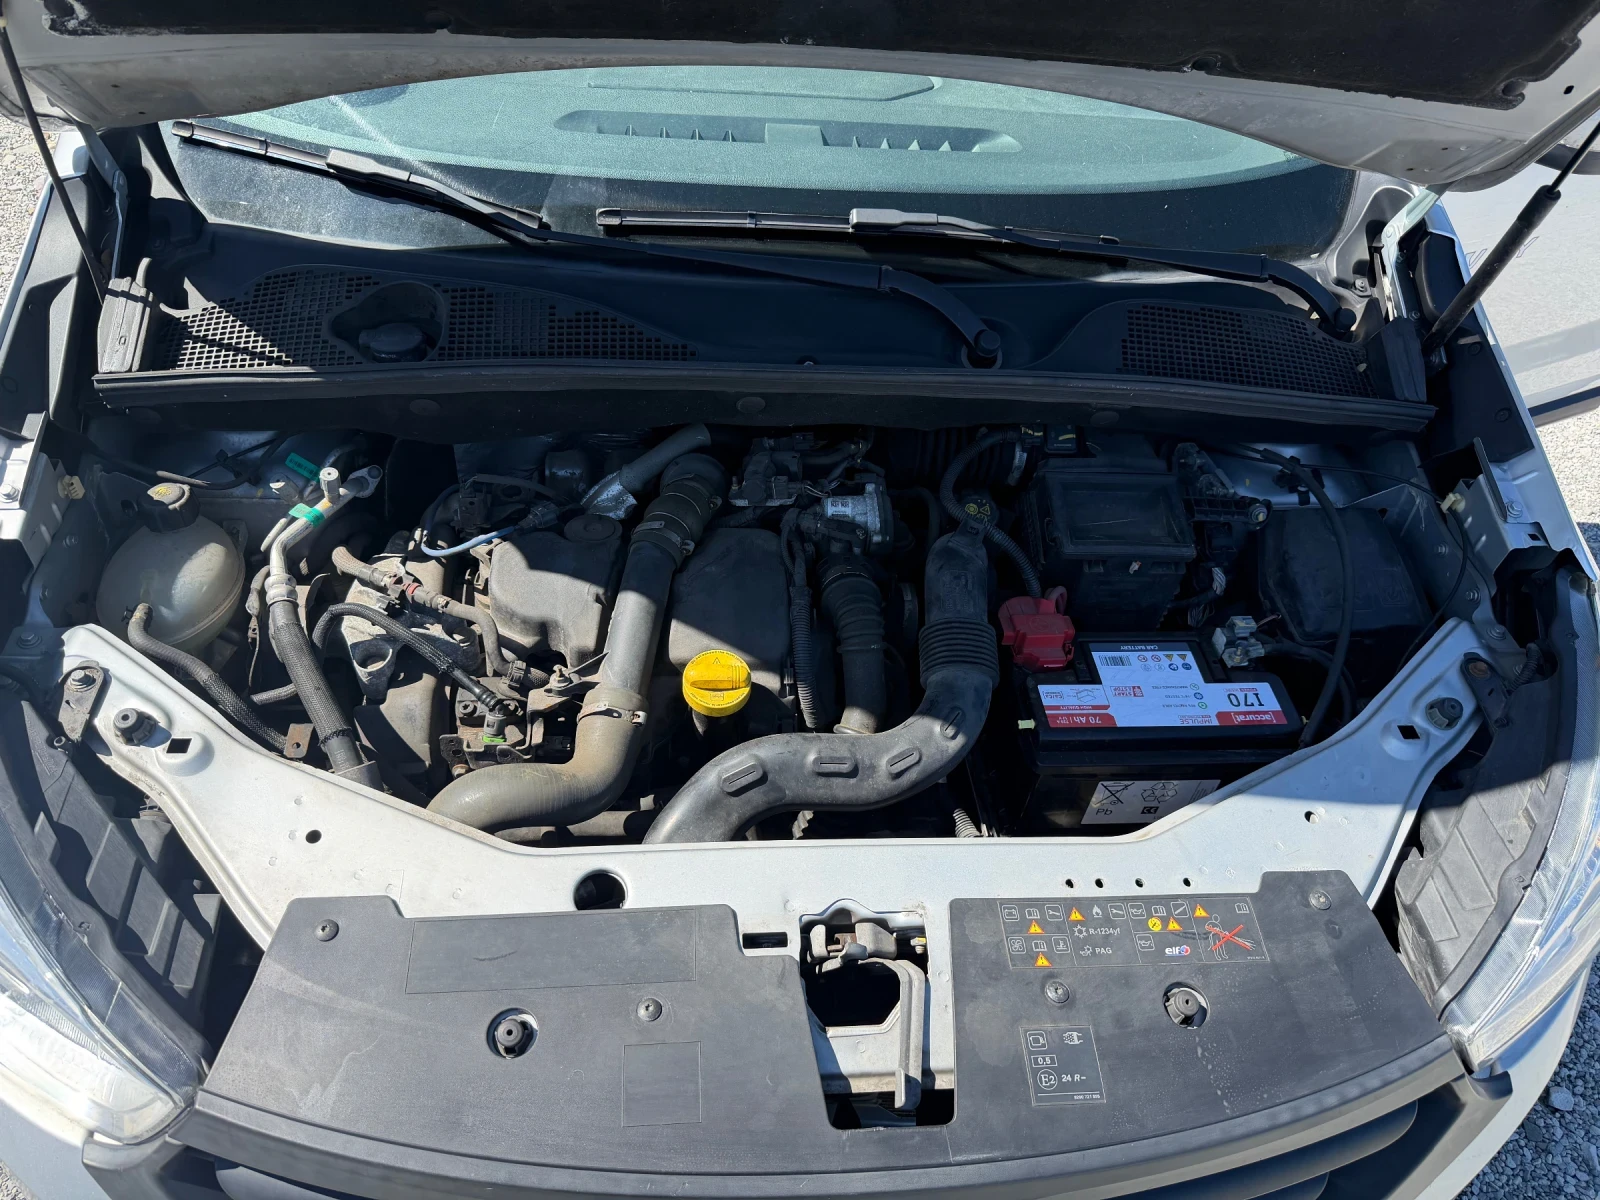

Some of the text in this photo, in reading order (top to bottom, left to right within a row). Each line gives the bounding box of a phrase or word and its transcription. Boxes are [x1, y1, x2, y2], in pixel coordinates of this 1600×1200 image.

[1089, 716, 1102, 724] 70
[1095, 808, 1113, 816] Pb
[1089, 928, 1120, 936] R-1234yf
[1164, 946, 1181, 955] elf
[1037, 1057, 1051, 1065] 0,5
[1041, 1074, 1056, 1086] E2
[1061, 1074, 1072, 1082] 24
